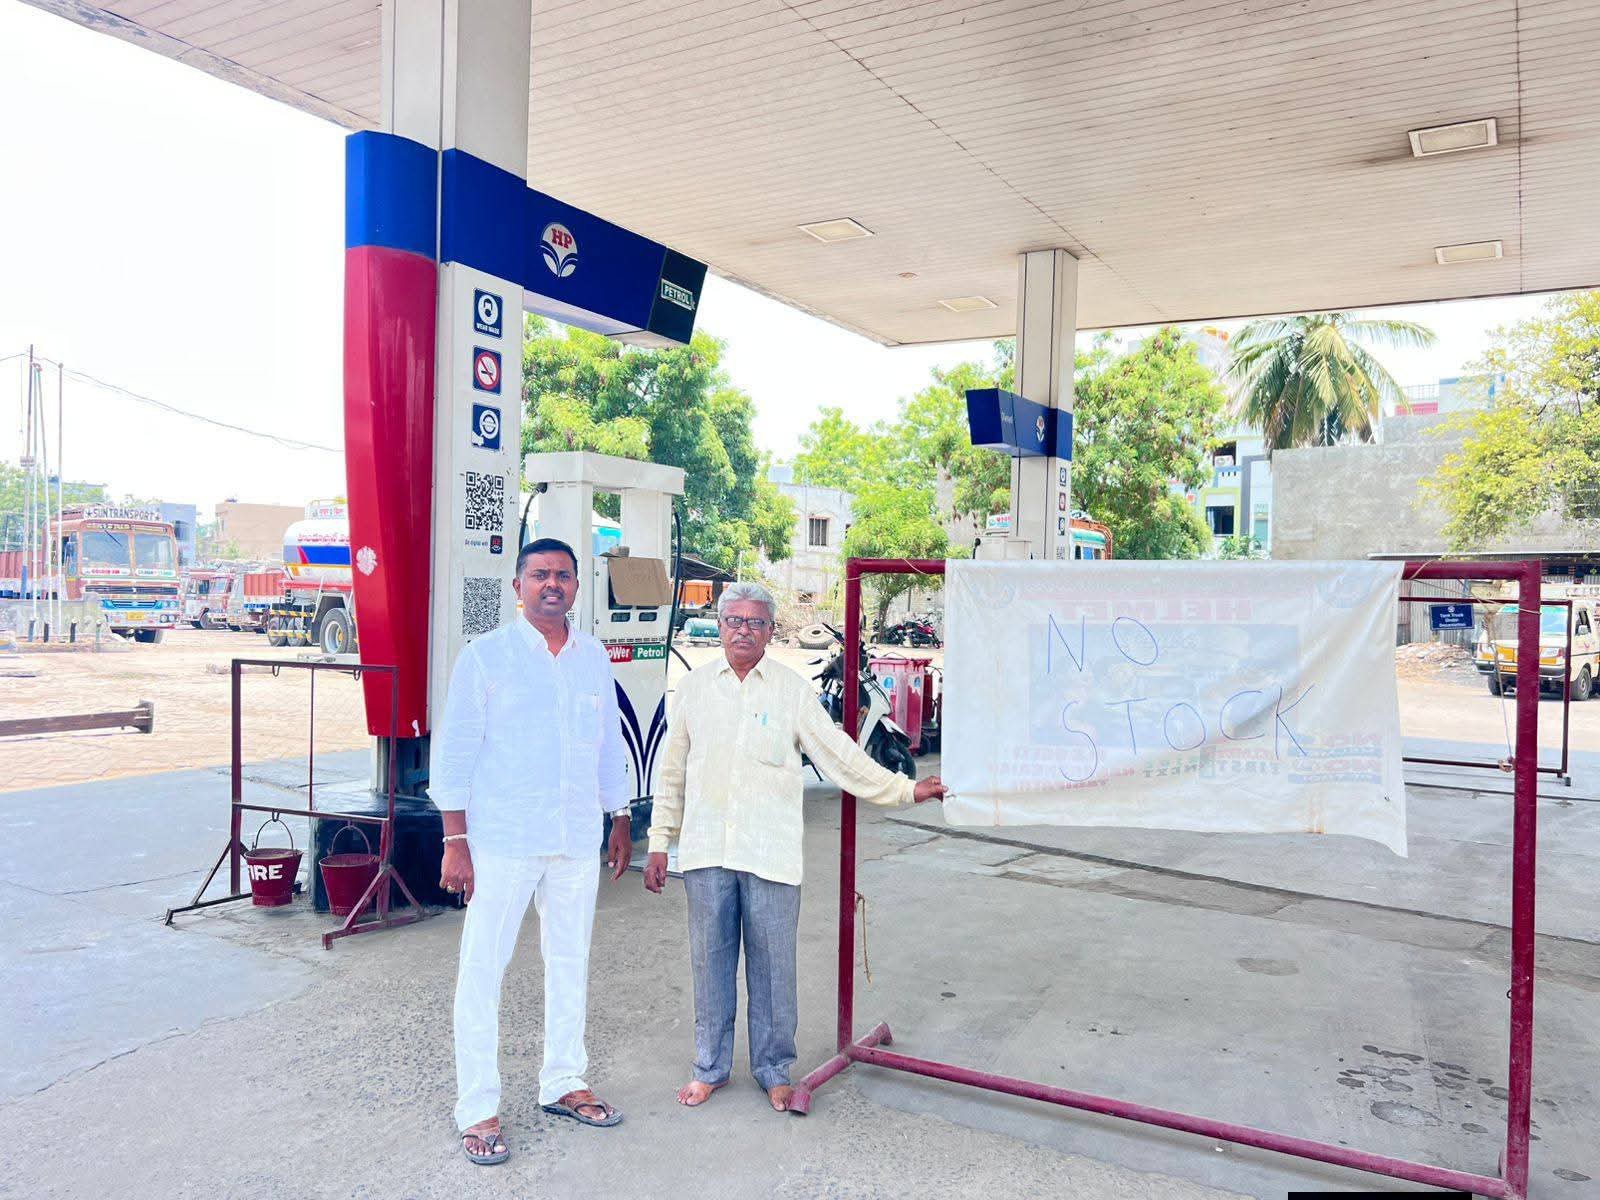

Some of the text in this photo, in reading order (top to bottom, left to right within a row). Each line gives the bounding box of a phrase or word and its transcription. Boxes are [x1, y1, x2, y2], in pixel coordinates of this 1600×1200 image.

[551, 228, 573, 249] HP
[664, 284, 690, 305] PETROL
[607, 646, 664, 660] oWer Petrol
[1047, 613, 1159, 674] NO
[1059, 684, 1316, 781] STOCK
